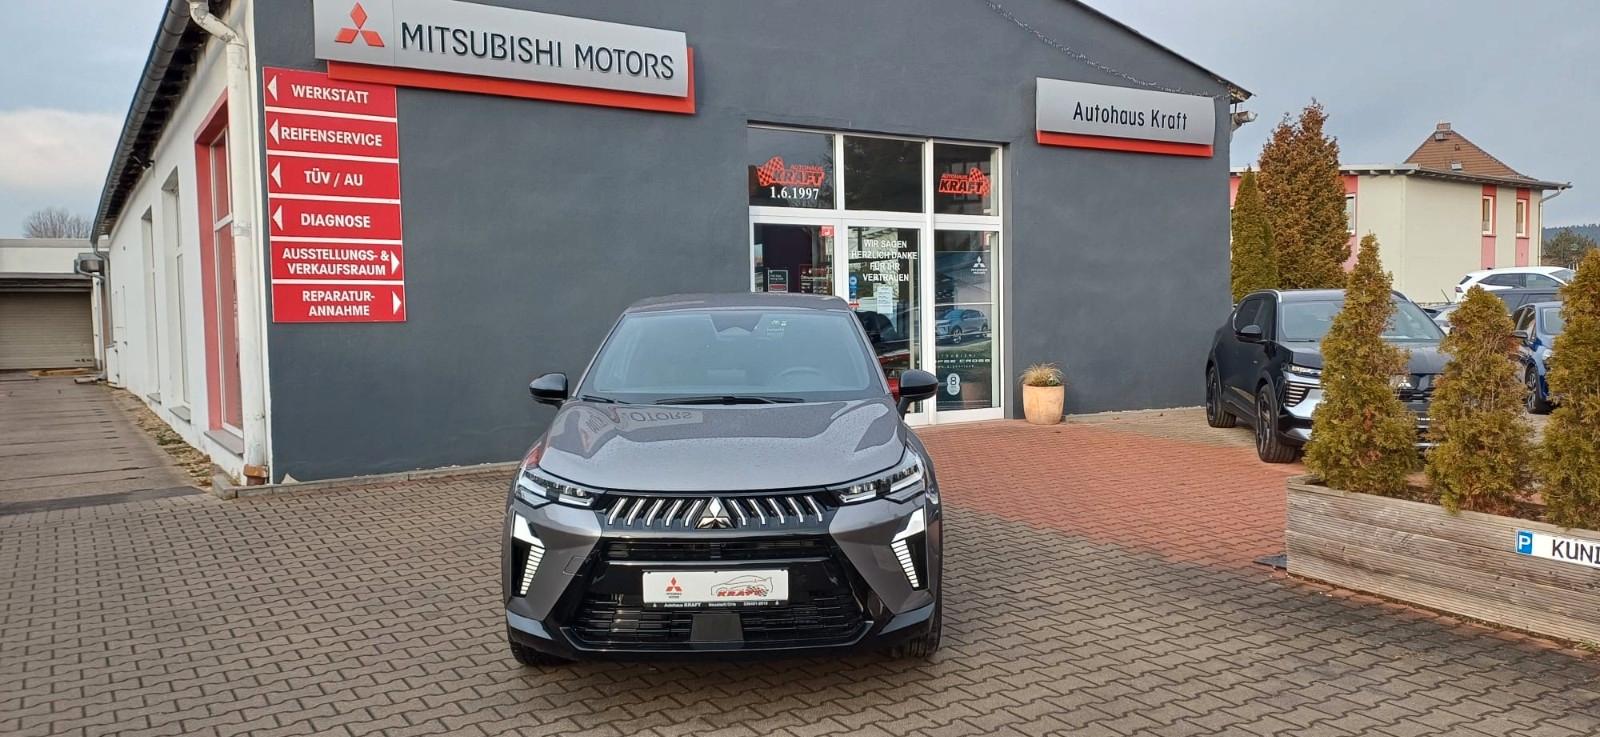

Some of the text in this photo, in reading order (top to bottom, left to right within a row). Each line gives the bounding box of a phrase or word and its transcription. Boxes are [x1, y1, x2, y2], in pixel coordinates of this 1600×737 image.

[401, 22, 674, 79] MITSUBISHI MOTORS
[291, 84, 369, 104] WERKSTATT
[1073, 101, 1187, 131] Autohaus Kraft
[281, 126, 383, 147] REIFENSERVICE
[304, 167, 363, 188] TÜV / AU
[770, 186, 819, 200] 1.6.1997
[939, 179, 984, 194] KRAFT
[300, 213, 371, 228] DIAGNOSE
[863, 239, 907, 249] WIR SAGEN
[282, 247, 390, 262] AUSSTELLUNGS- &
[851, 249, 918, 259] HERZLICH DANKE
[287, 263, 386, 276] VERKAUFSRAUM
[887, 261, 901, 271] IHR
[862, 273, 909, 282] VERTRAUEN
[302, 290, 376, 302] REPARATUR-
[308, 305, 370, 317] ANNAHME
[1518, 534, 1532, 550] P
